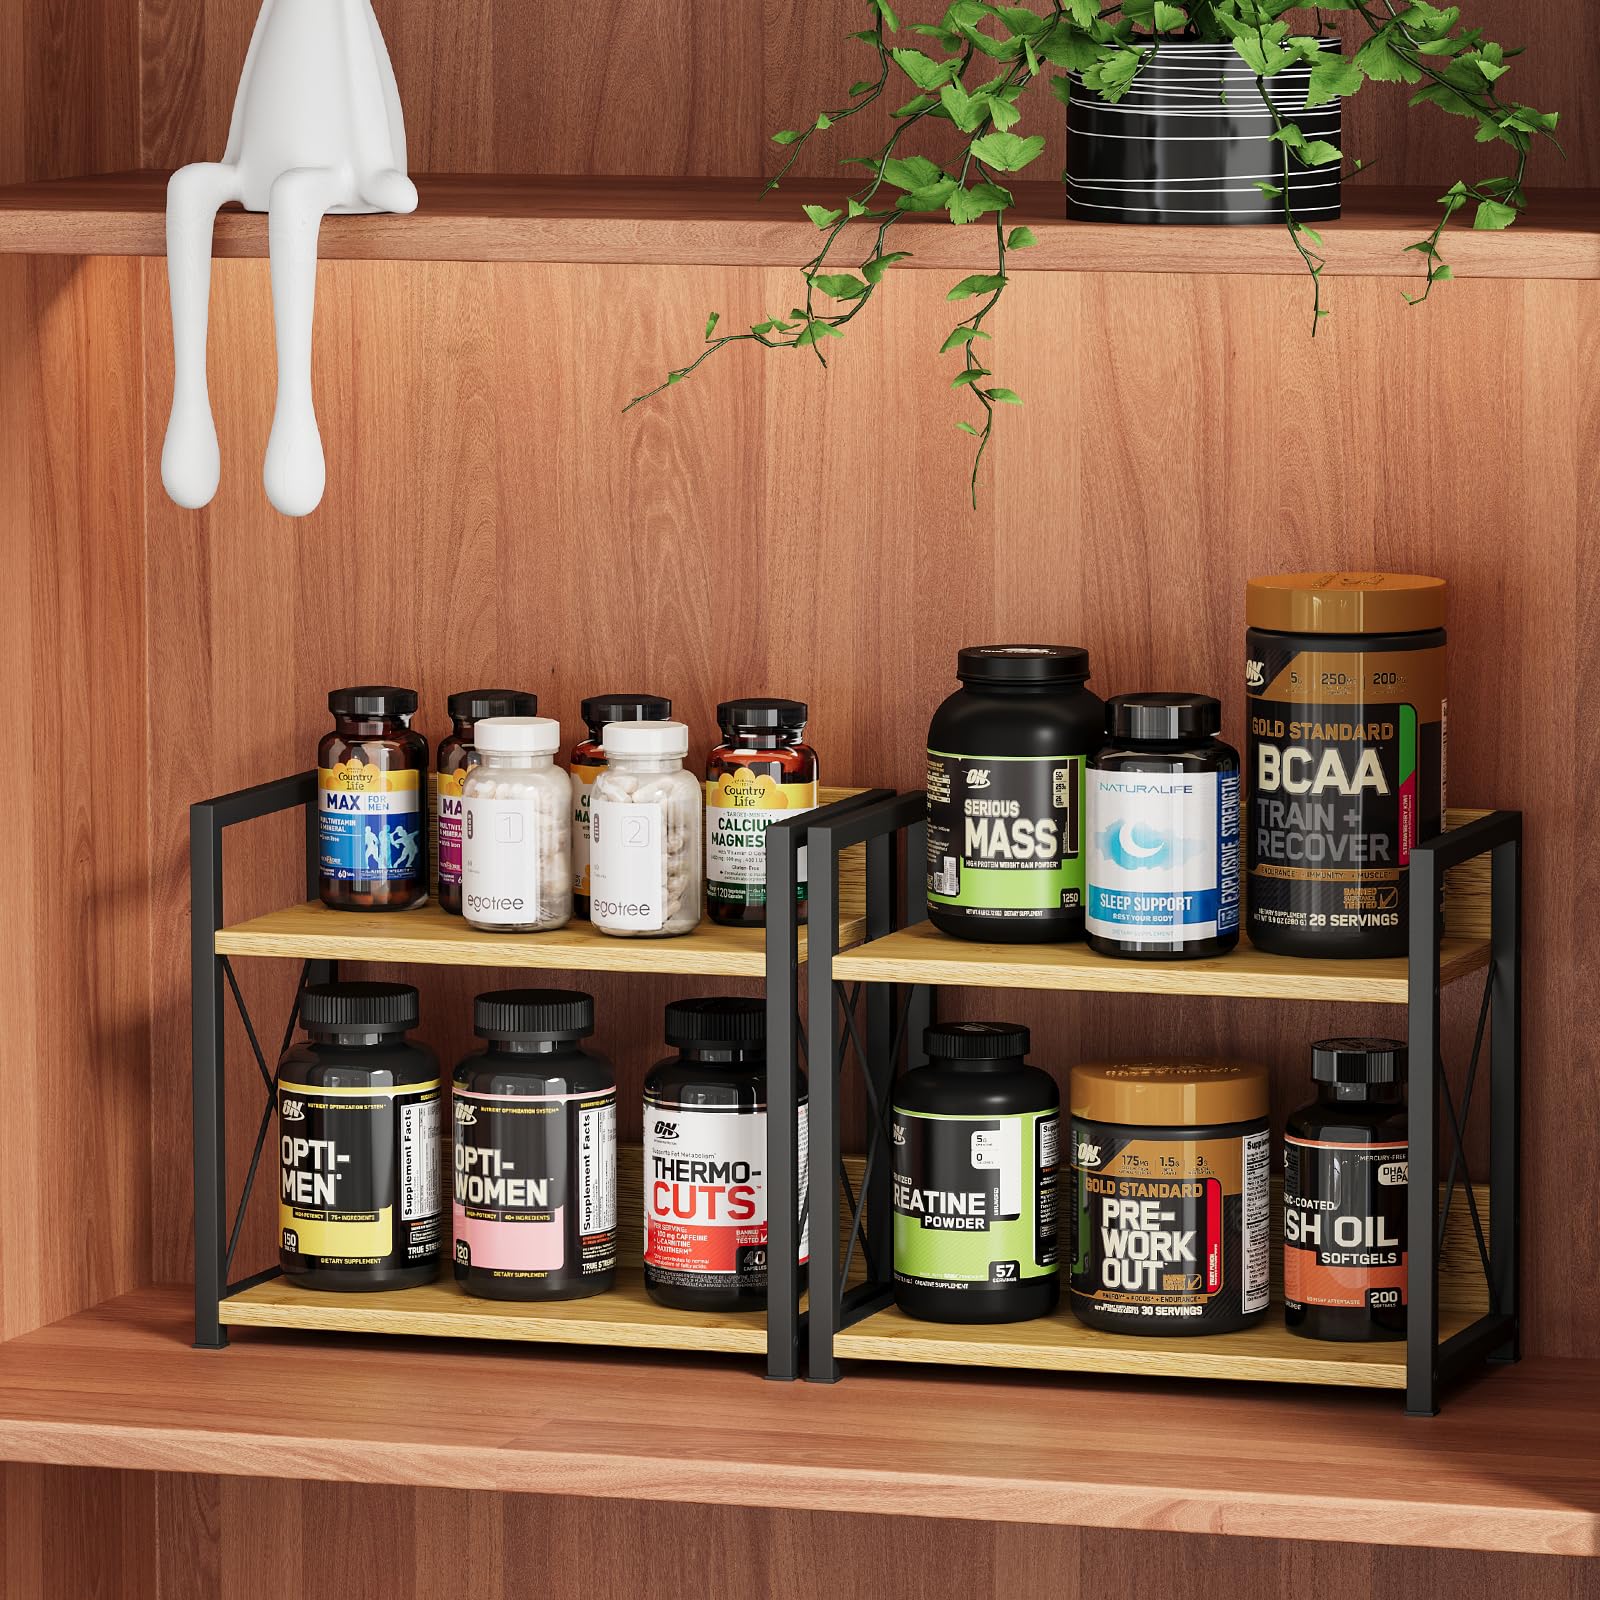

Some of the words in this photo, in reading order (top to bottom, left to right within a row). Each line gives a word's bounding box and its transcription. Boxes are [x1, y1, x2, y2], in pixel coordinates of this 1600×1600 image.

[1252, 717, 1284, 737] GOLD
[1289, 722, 1393, 741] STANDARD
[339, 772, 372, 783] Country
[1259, 743, 1390, 796] BCAA
[347, 781, 364, 790] Life
[724, 785, 765, 798] Country
[1100, 782, 1192, 794] NATURALIFE
[327, 793, 360, 810] MAX
[443, 799, 462, 815] MA
[734, 796, 755, 806] Life
[964, 799, 1020, 817] SERIOUS
[1221, 777, 1239, 837] STRENGTH
[1257, 798, 1334, 831] TRAIN
[628, 820, 642, 843] 2
[712, 832, 766, 847] MAGNES
[965, 818, 1058, 859] MASS
[1257, 828, 1390, 862] RECOVER
[1221, 843, 1238, 904] EXPLOSIVE
[717, 887, 728, 898] 120
[1063, 893, 1078, 903] 1250
[1344, 888, 1376, 896] BANNED
[468, 894, 524, 912] egotree
[594, 899, 650, 917] egotree
[1100, 893, 1131, 910] SLEEP
[1134, 896, 1192, 911] SUPPORT
[1344, 901, 1376, 909] TESTED
[1309, 914, 1326, 926] 28
[1330, 913, 1398, 926] SERVINGS
[282, 1136, 350, 1170] OPTI-
[456, 1144, 514, 1177] OPTI-
[652, 1156, 761, 1184] THERMO-
[282, 1168, 336, 1205] MEN
[455, 1171, 548, 1207] WOMEN
[1086, 1177, 1115, 1194] GOLD
[1119, 1181, 1203, 1198] STANDARD
[654, 1181, 756, 1220] CUTS
[894, 1183, 986, 1216] REATINE
[925, 1216, 984, 1229] POWDER
[1102, 1197, 1176, 1231] PRE-
[284, 1232, 296, 1246] 150
[667, 1233, 675, 1241] mg
[676, 1234, 708, 1242] CAFFEINE
[1335, 1216, 1398, 1247] OIL
[408, 1246, 424, 1255] TRUE
[657, 1238, 690, 1248] L-CARNITINE
[1101, 1226, 1197, 1262] WORK
[456, 1245, 468, 1259] 120
[744, 1251, 766, 1266] 40
[1322, 1252, 1397, 1264] SOFTGELS
[582, 1261, 598, 1270] TRUE
[996, 1264, 1014, 1277] 57
[1102, 1258, 1164, 1291] OUT
[1371, 1291, 1397, 1303] 200
[1141, 1306, 1153, 1315] 30
[1156, 1306, 1202, 1316] SERVINGS
